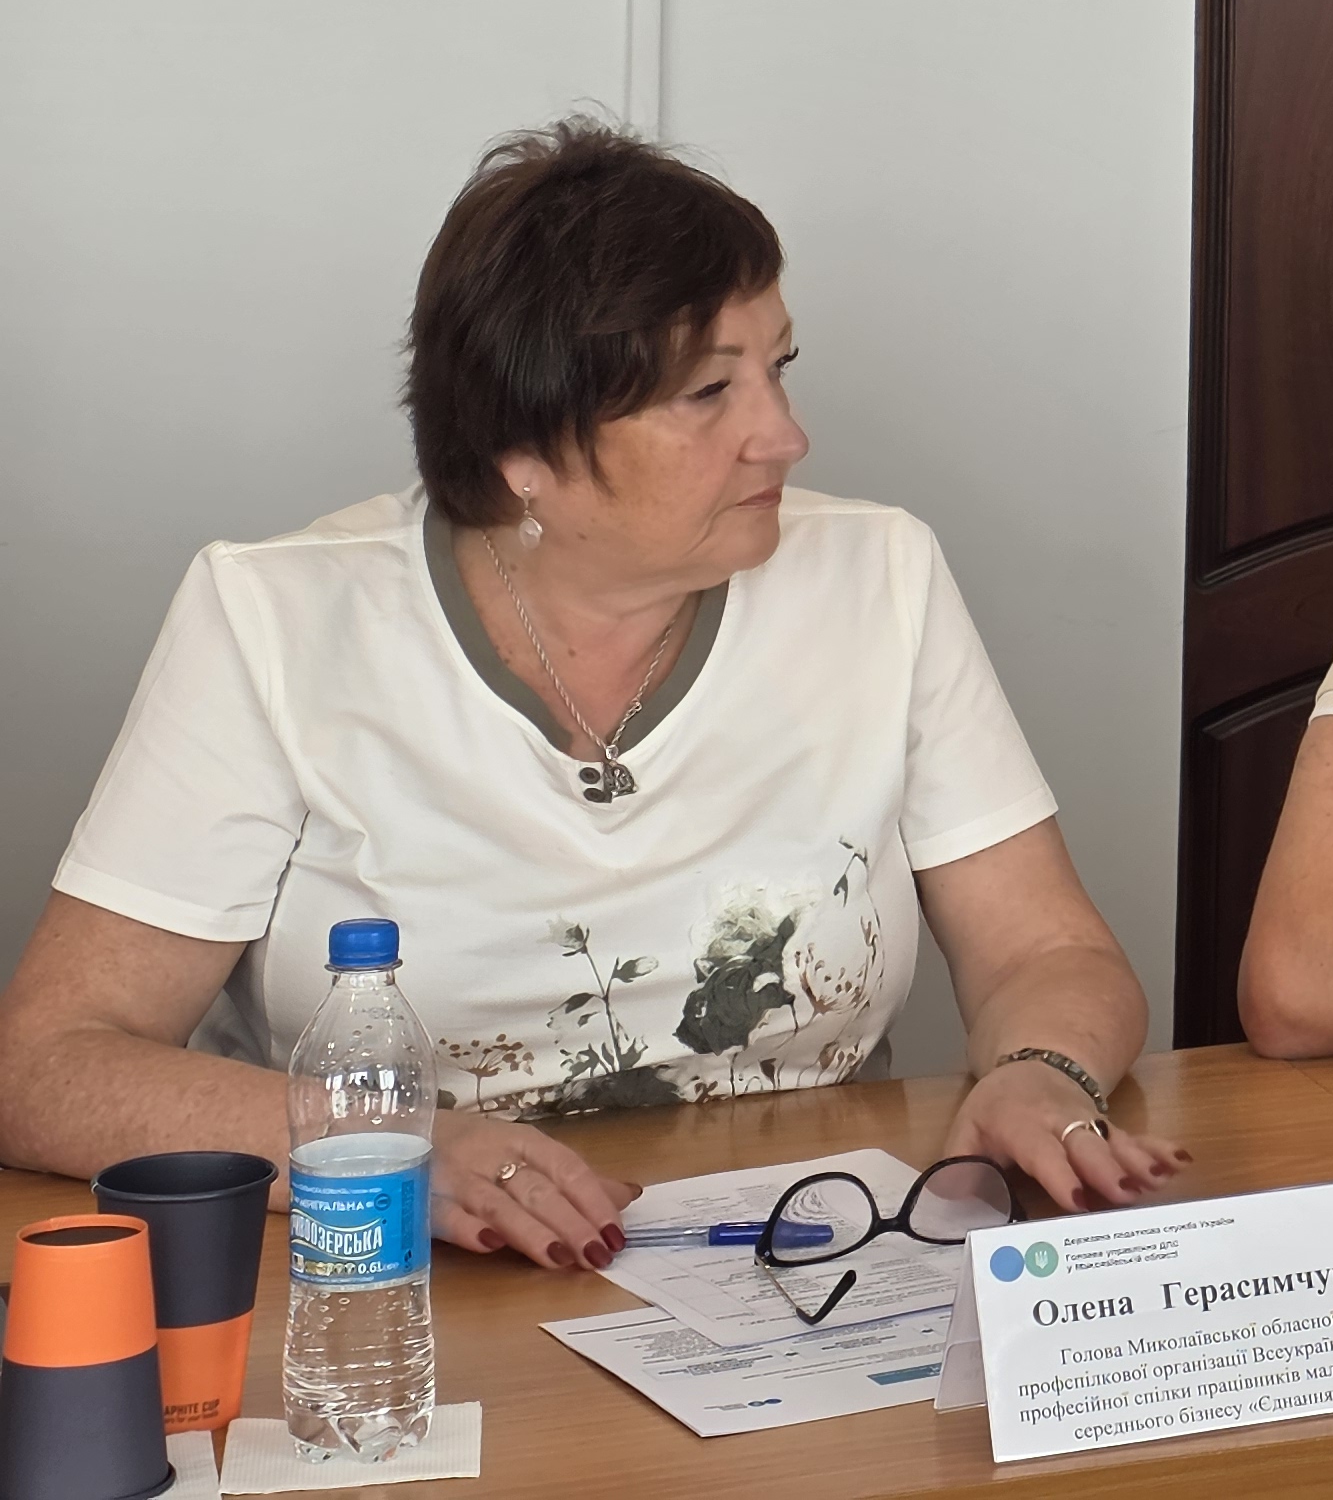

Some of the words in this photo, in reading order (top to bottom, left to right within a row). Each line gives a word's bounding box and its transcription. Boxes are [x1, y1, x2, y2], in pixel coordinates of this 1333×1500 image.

[1033, 1295, 1134, 1326] Олена
[1060, 1346, 1123, 1365] Голова
[1128, 1321, 1256, 1356] Миколаївської
[1018, 1364, 1147, 1397] профспілкової
[1153, 1350, 1248, 1380] організації
[1020, 1391, 1129, 1425] професійної
[1135, 1381, 1192, 1406] спілки
[1197, 1366, 1300, 1400] працівників
[1074, 1415, 1174, 1442] середнього
[1179, 1403, 1242, 1426] бізнесу
